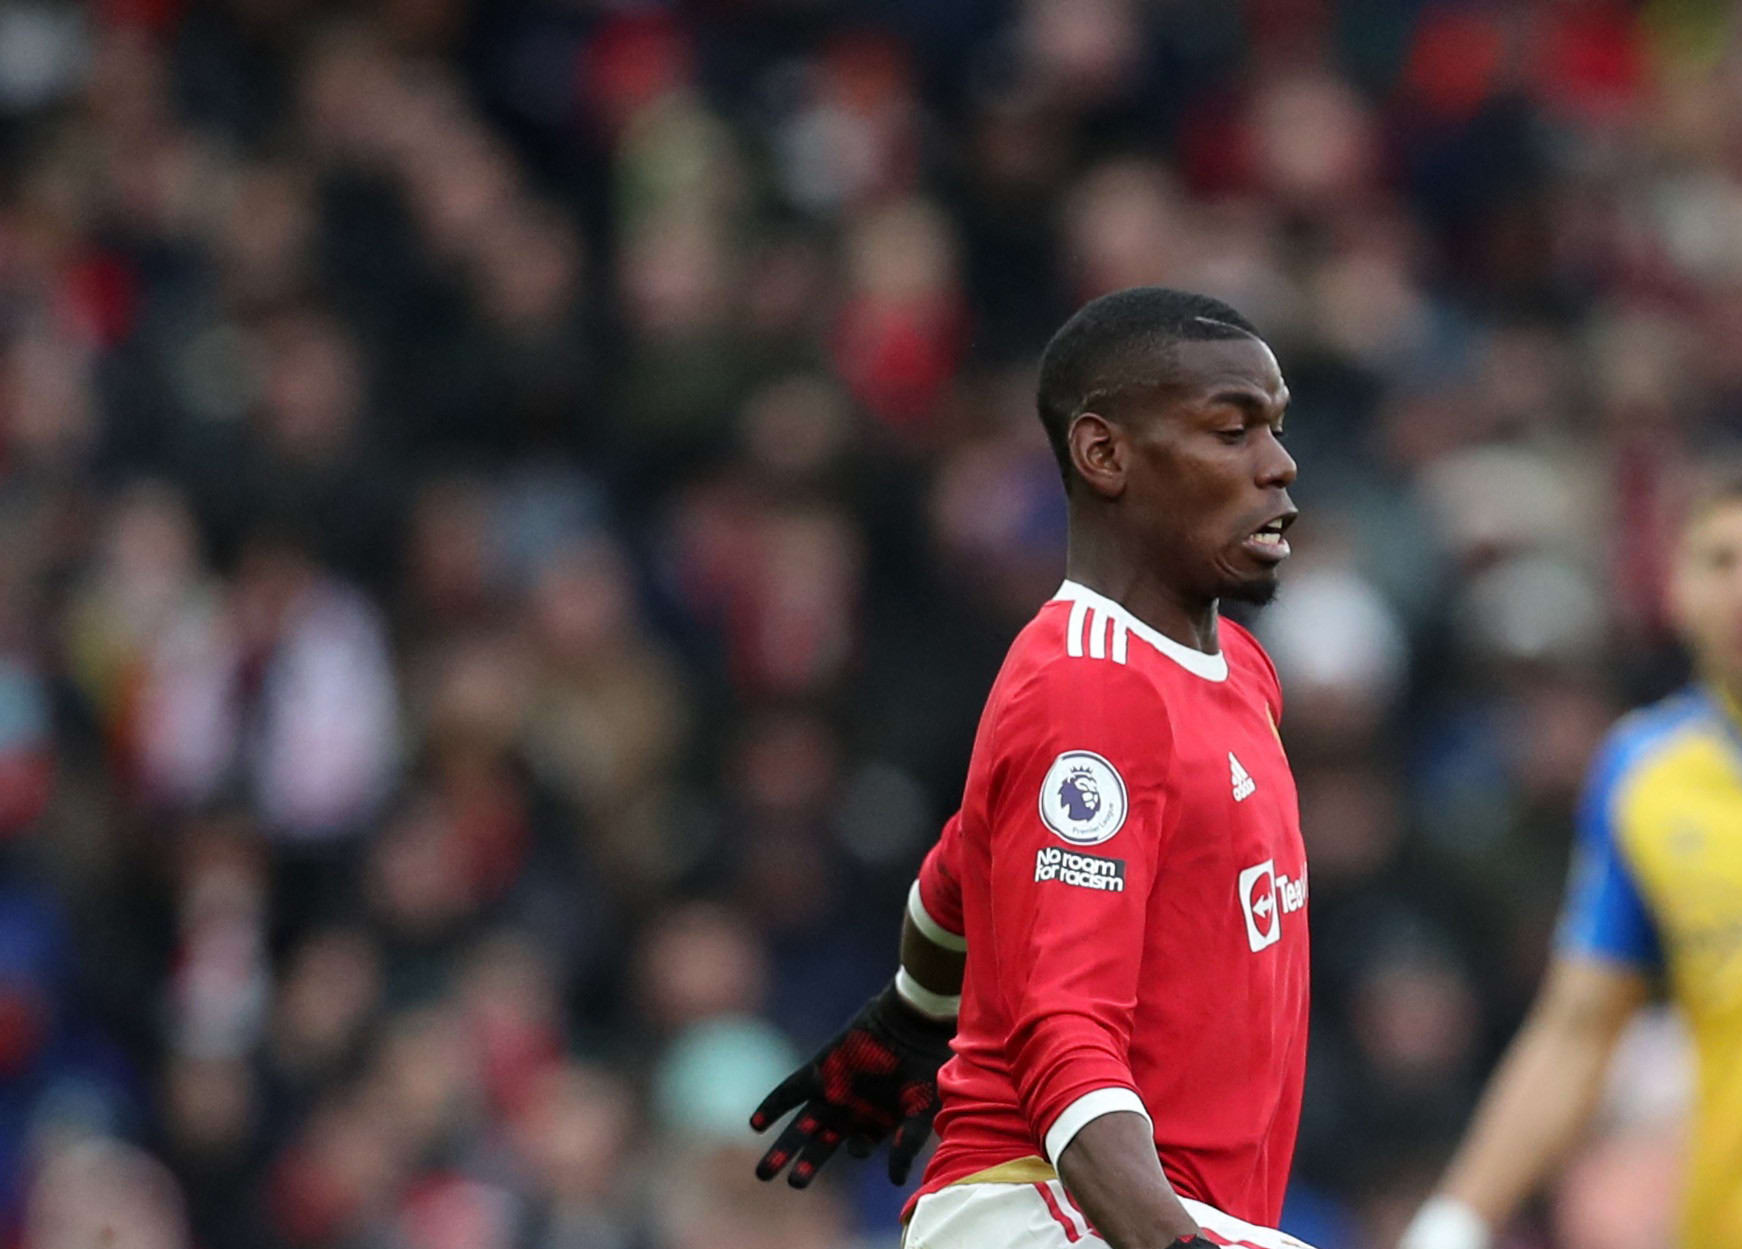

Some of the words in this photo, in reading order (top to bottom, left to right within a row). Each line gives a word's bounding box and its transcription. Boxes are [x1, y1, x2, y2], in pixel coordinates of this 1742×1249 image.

[1036, 847, 1061, 866] No
[1062, 852, 1116, 877] room
[1034, 863, 1060, 882] for
[1060, 866, 1125, 892] racism
